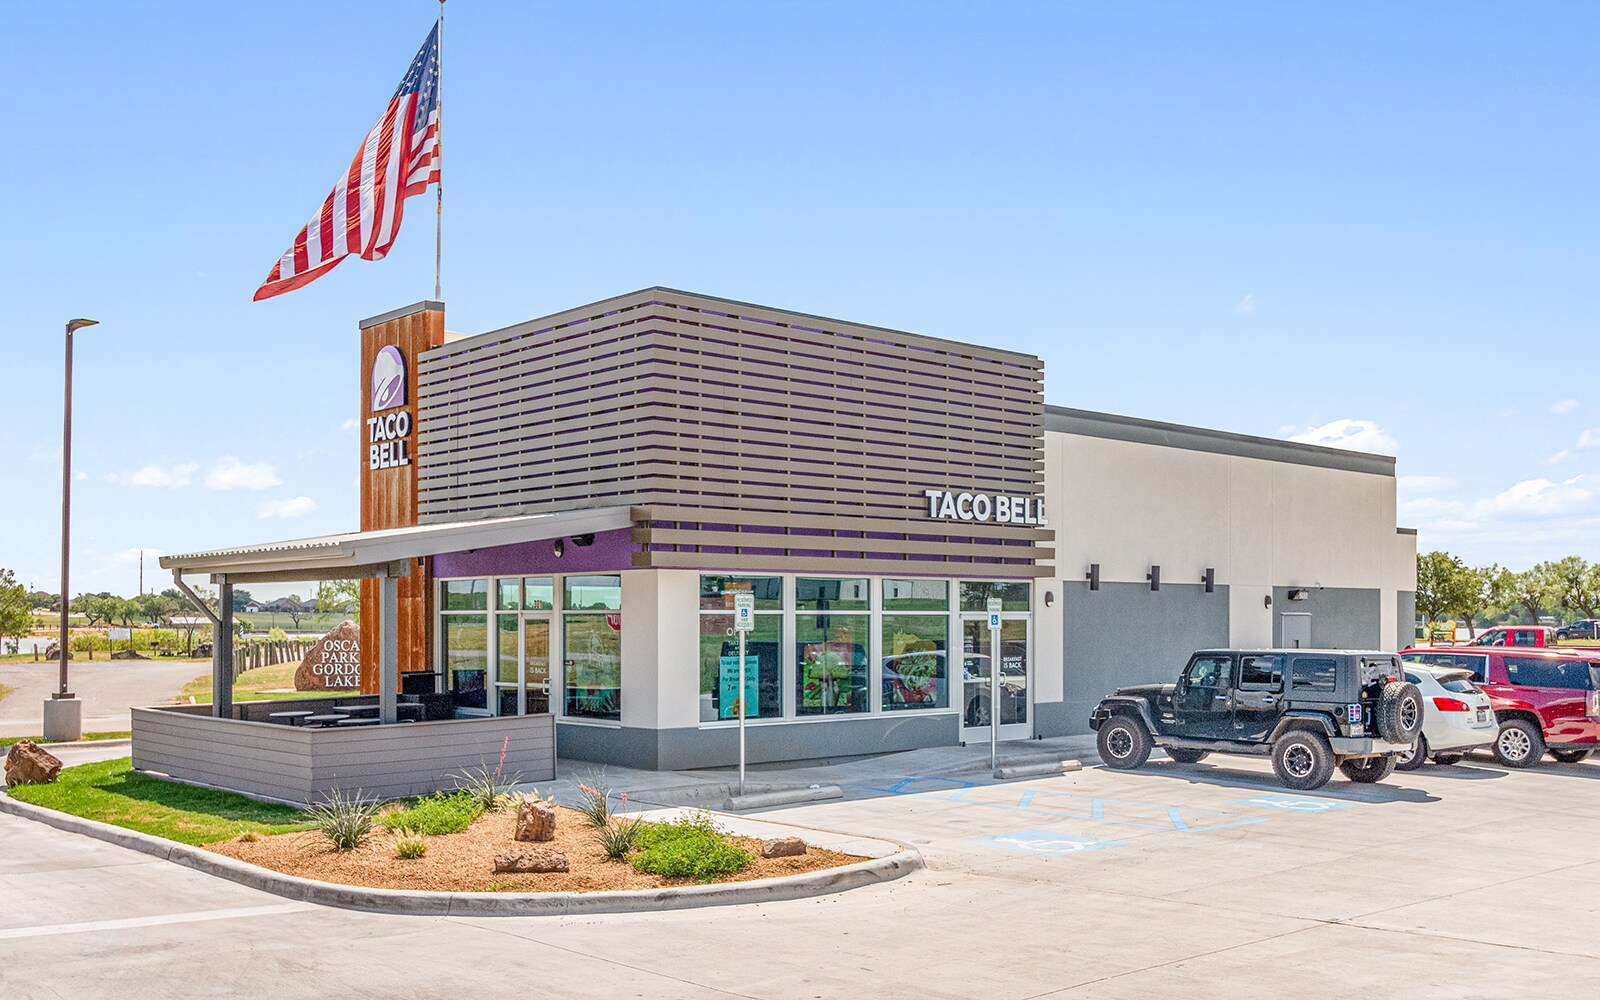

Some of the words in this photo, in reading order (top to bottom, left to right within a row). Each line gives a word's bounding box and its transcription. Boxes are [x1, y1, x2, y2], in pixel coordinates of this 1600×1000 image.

[367, 411, 409, 443] TACO
[370, 440, 409, 470] BELL
[925, 490, 991, 521] TACO
[996, 495, 1048, 525] BELL
[321, 652, 359, 663] PARK
